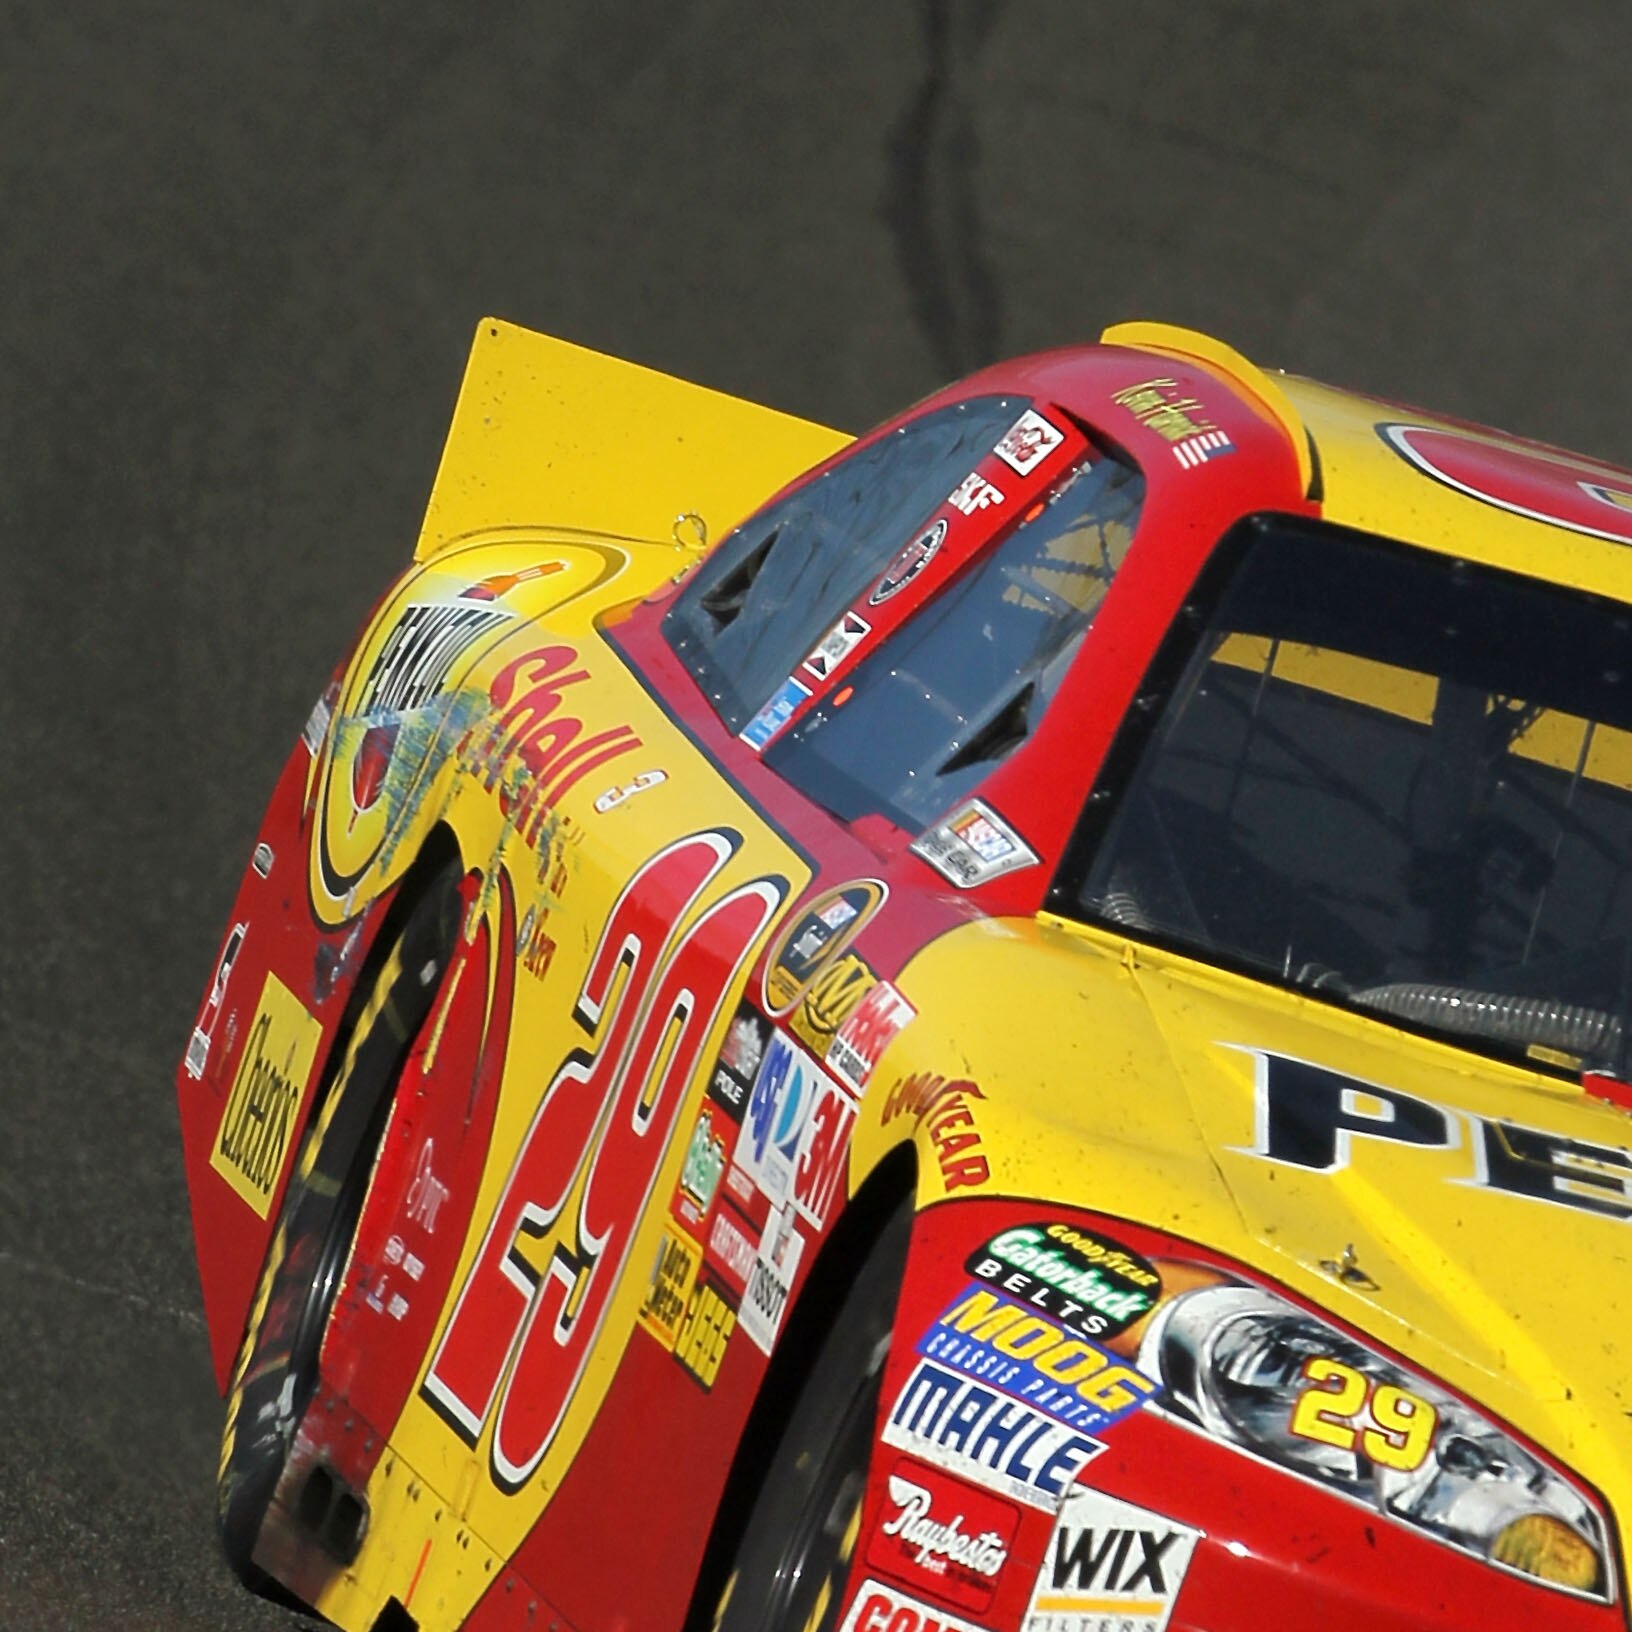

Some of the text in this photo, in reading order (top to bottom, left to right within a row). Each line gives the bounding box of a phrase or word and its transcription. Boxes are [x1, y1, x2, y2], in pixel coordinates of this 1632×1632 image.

[221, 1013, 297, 1193] Cheerios
[715, 1069, 744, 1104] POLE
[418, 826, 790, 1495] 29
[975, 1258, 1108, 1334] BELTS
[988, 1228, 1151, 1322] Gatorback
[1047, 1224, 1158, 1287] GOODYEAR
[926, 1332, 1100, 1426] CHASSIS PARTS
[939, 1290, 1155, 1413] MOOG
[893, 1364, 1100, 1498] MAHLE
[1290, 1356, 1440, 1472] 29
[883, 1475, 1008, 1576] Raybestos
[1051, 1526, 1182, 1594] WIX
